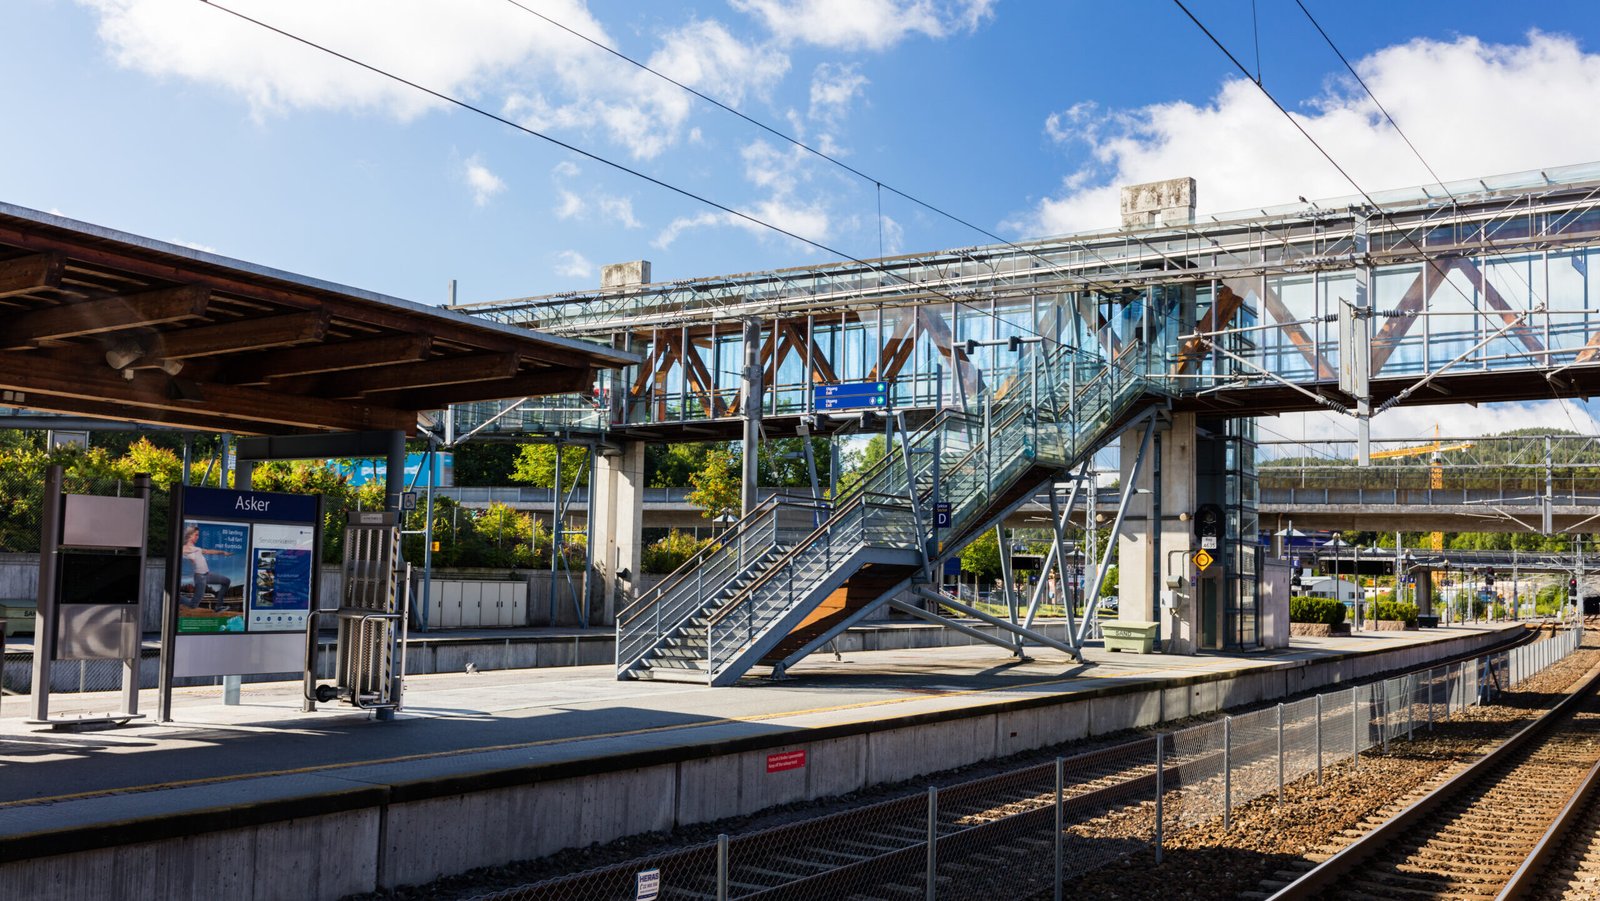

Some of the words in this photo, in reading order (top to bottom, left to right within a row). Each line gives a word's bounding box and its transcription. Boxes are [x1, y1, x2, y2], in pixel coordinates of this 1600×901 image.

[235, 496, 270, 512] Asker
[938, 513, 946, 524] D
[640, 872, 659, 883] HERAS
